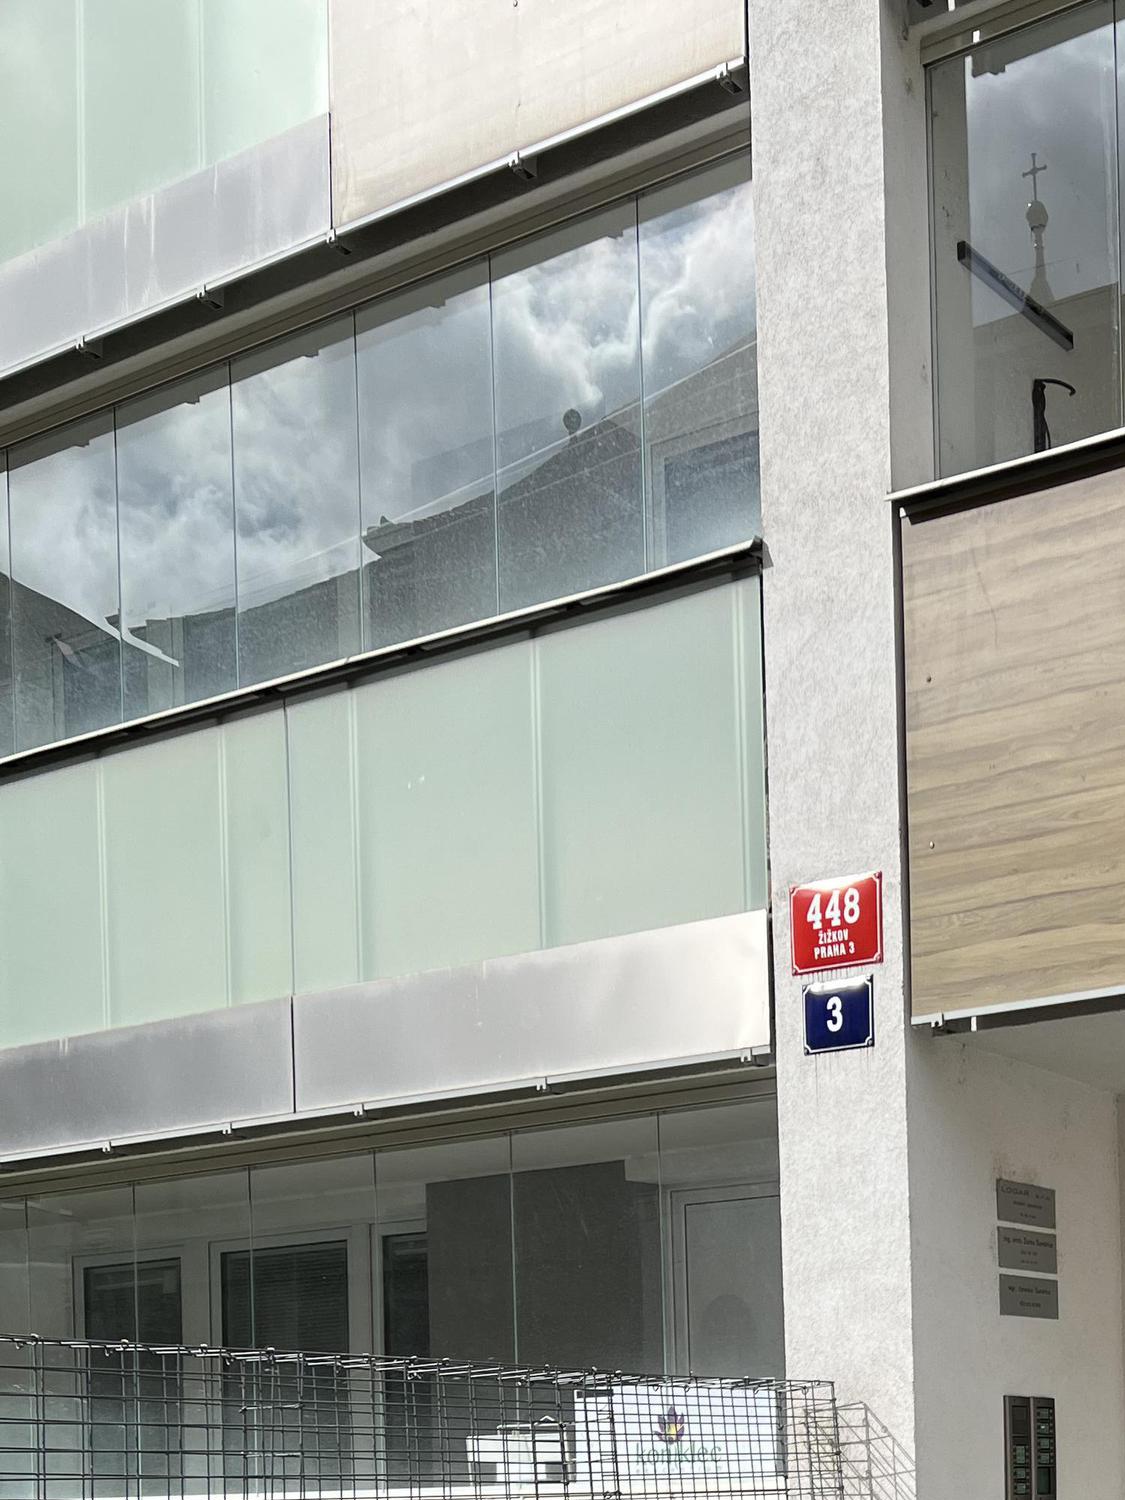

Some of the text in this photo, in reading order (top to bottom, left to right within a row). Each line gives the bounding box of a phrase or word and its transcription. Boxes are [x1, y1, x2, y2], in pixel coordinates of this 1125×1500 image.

[806, 887, 860, 930] 448
[818, 928, 849, 944] ŽIŽKOV
[814, 941, 856, 960] PRAHA 3
[826, 996, 843, 1032] 3
